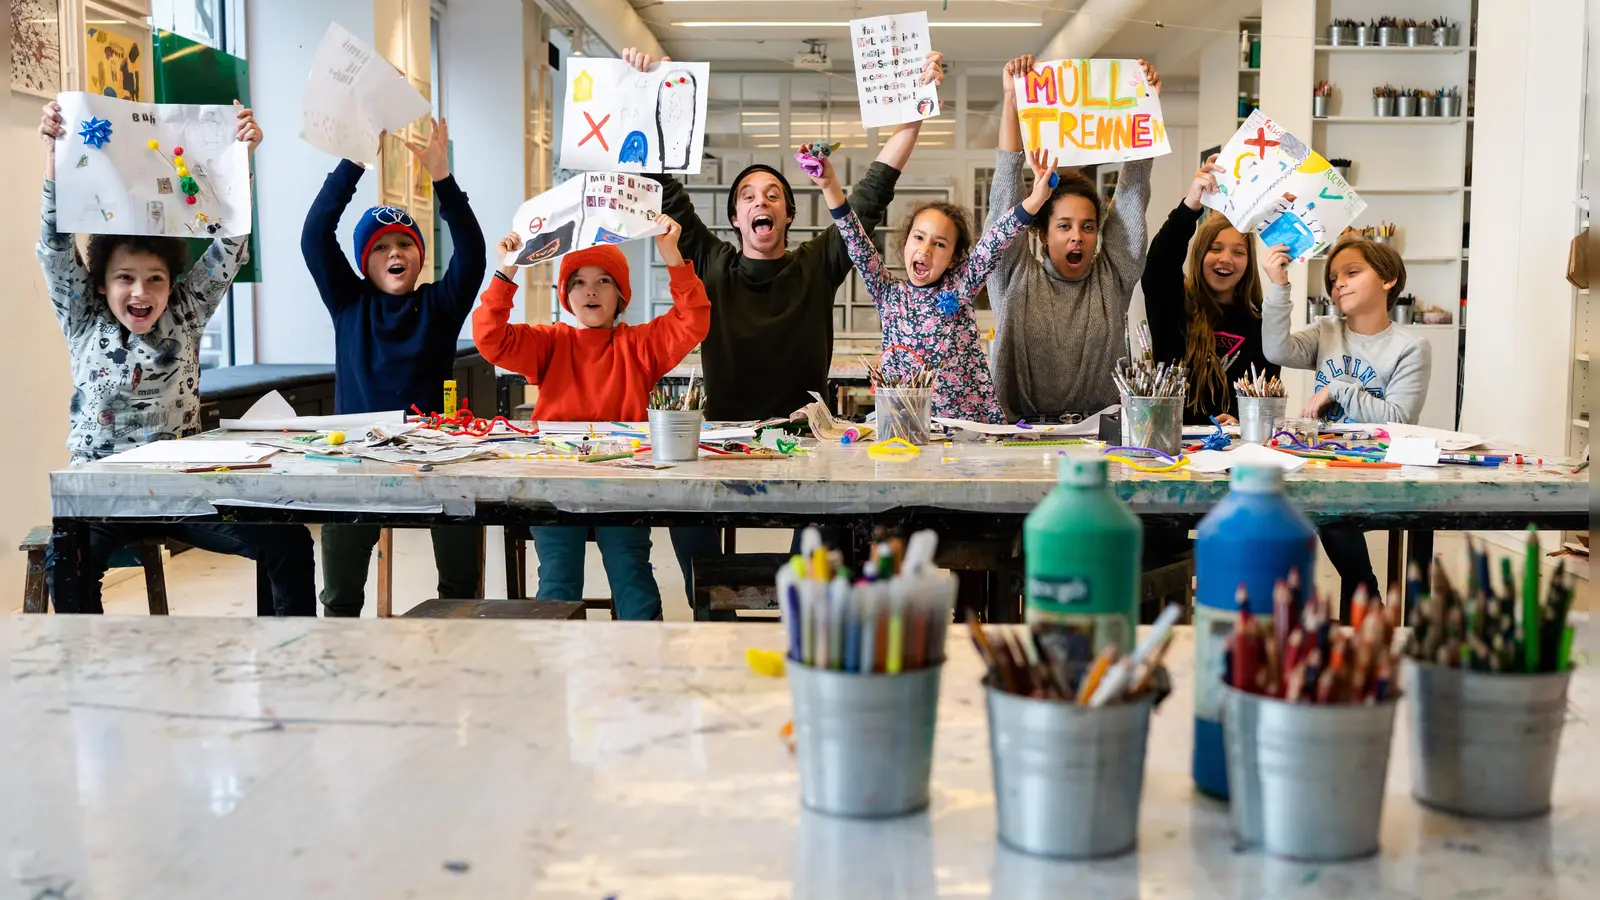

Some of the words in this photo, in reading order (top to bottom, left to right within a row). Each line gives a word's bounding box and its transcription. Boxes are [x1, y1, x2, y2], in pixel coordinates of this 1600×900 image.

[1025, 58, 1137, 108] MÜLL
[132, 112, 156, 124] Buh
[1018, 107, 1164, 153] TRENNEN
